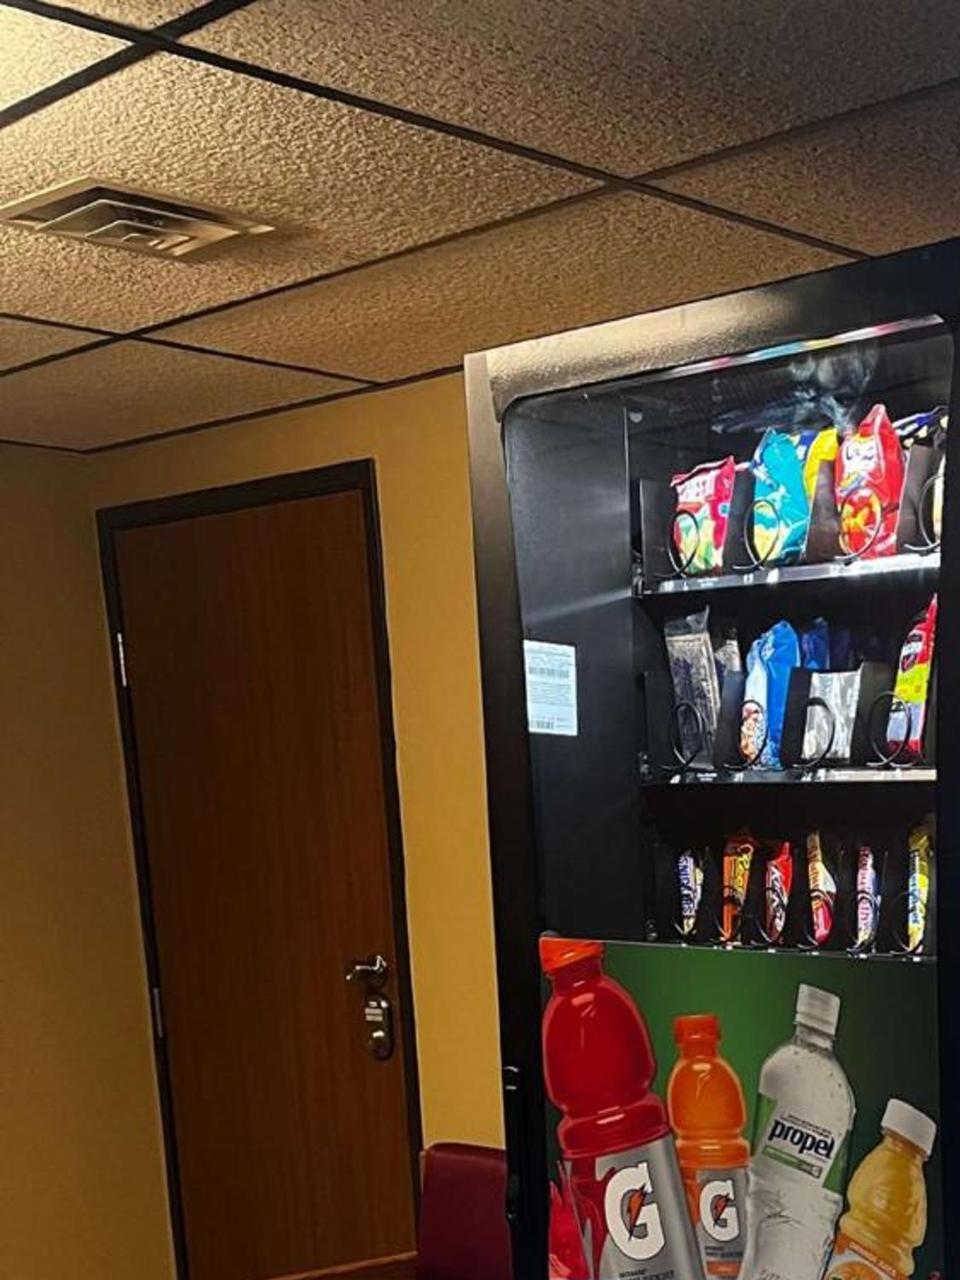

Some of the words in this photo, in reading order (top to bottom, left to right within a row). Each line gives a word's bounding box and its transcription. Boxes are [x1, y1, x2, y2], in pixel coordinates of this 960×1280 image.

[677, 855, 696, 917] SNICRS
[768, 1119, 836, 1159] propel
[604, 1161, 666, 1261] G
[701, 1179, 740, 1242] G
